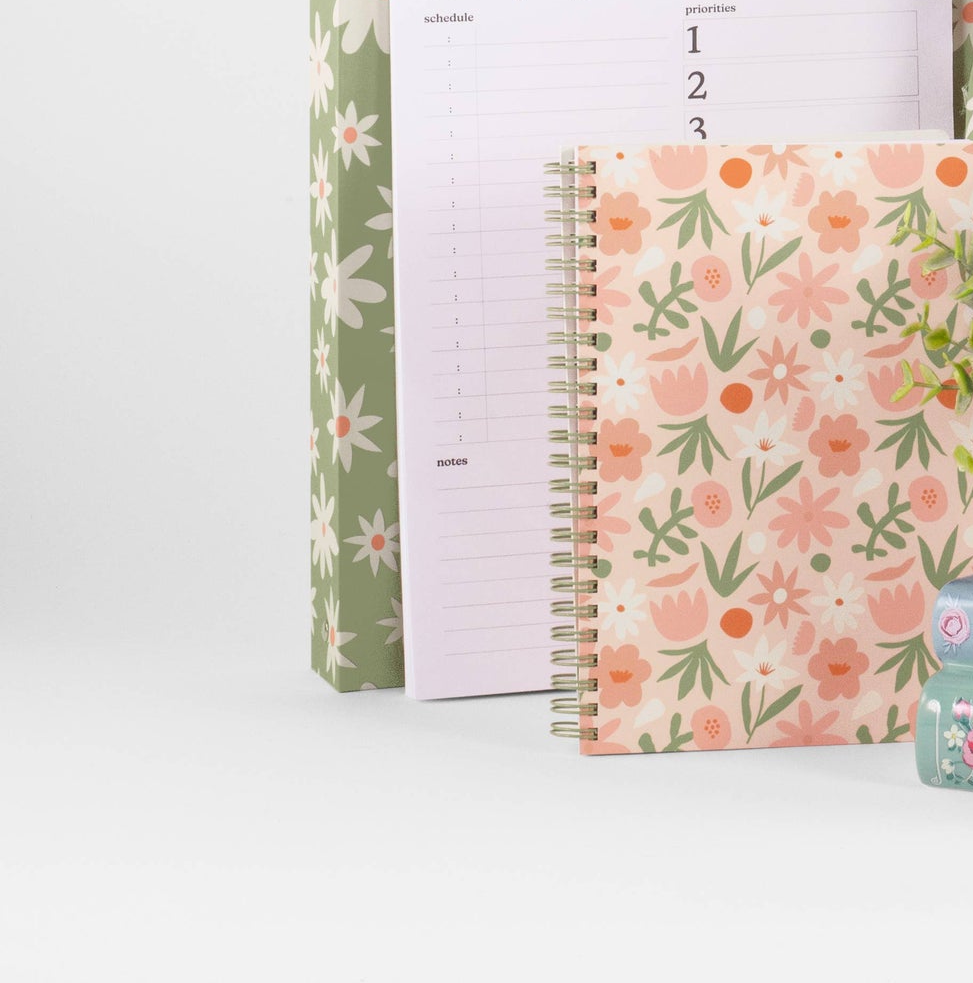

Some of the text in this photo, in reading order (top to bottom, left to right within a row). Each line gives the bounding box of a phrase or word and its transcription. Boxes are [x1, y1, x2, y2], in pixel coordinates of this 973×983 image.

[423, 12, 475, 24] schedule
[685, 3, 736, 16] priorities
[686, 25, 701, 54] 1
[687, 70, 707, 100] 2
[689, 116, 707, 140] 3
[437, 457, 468, 468] notes
